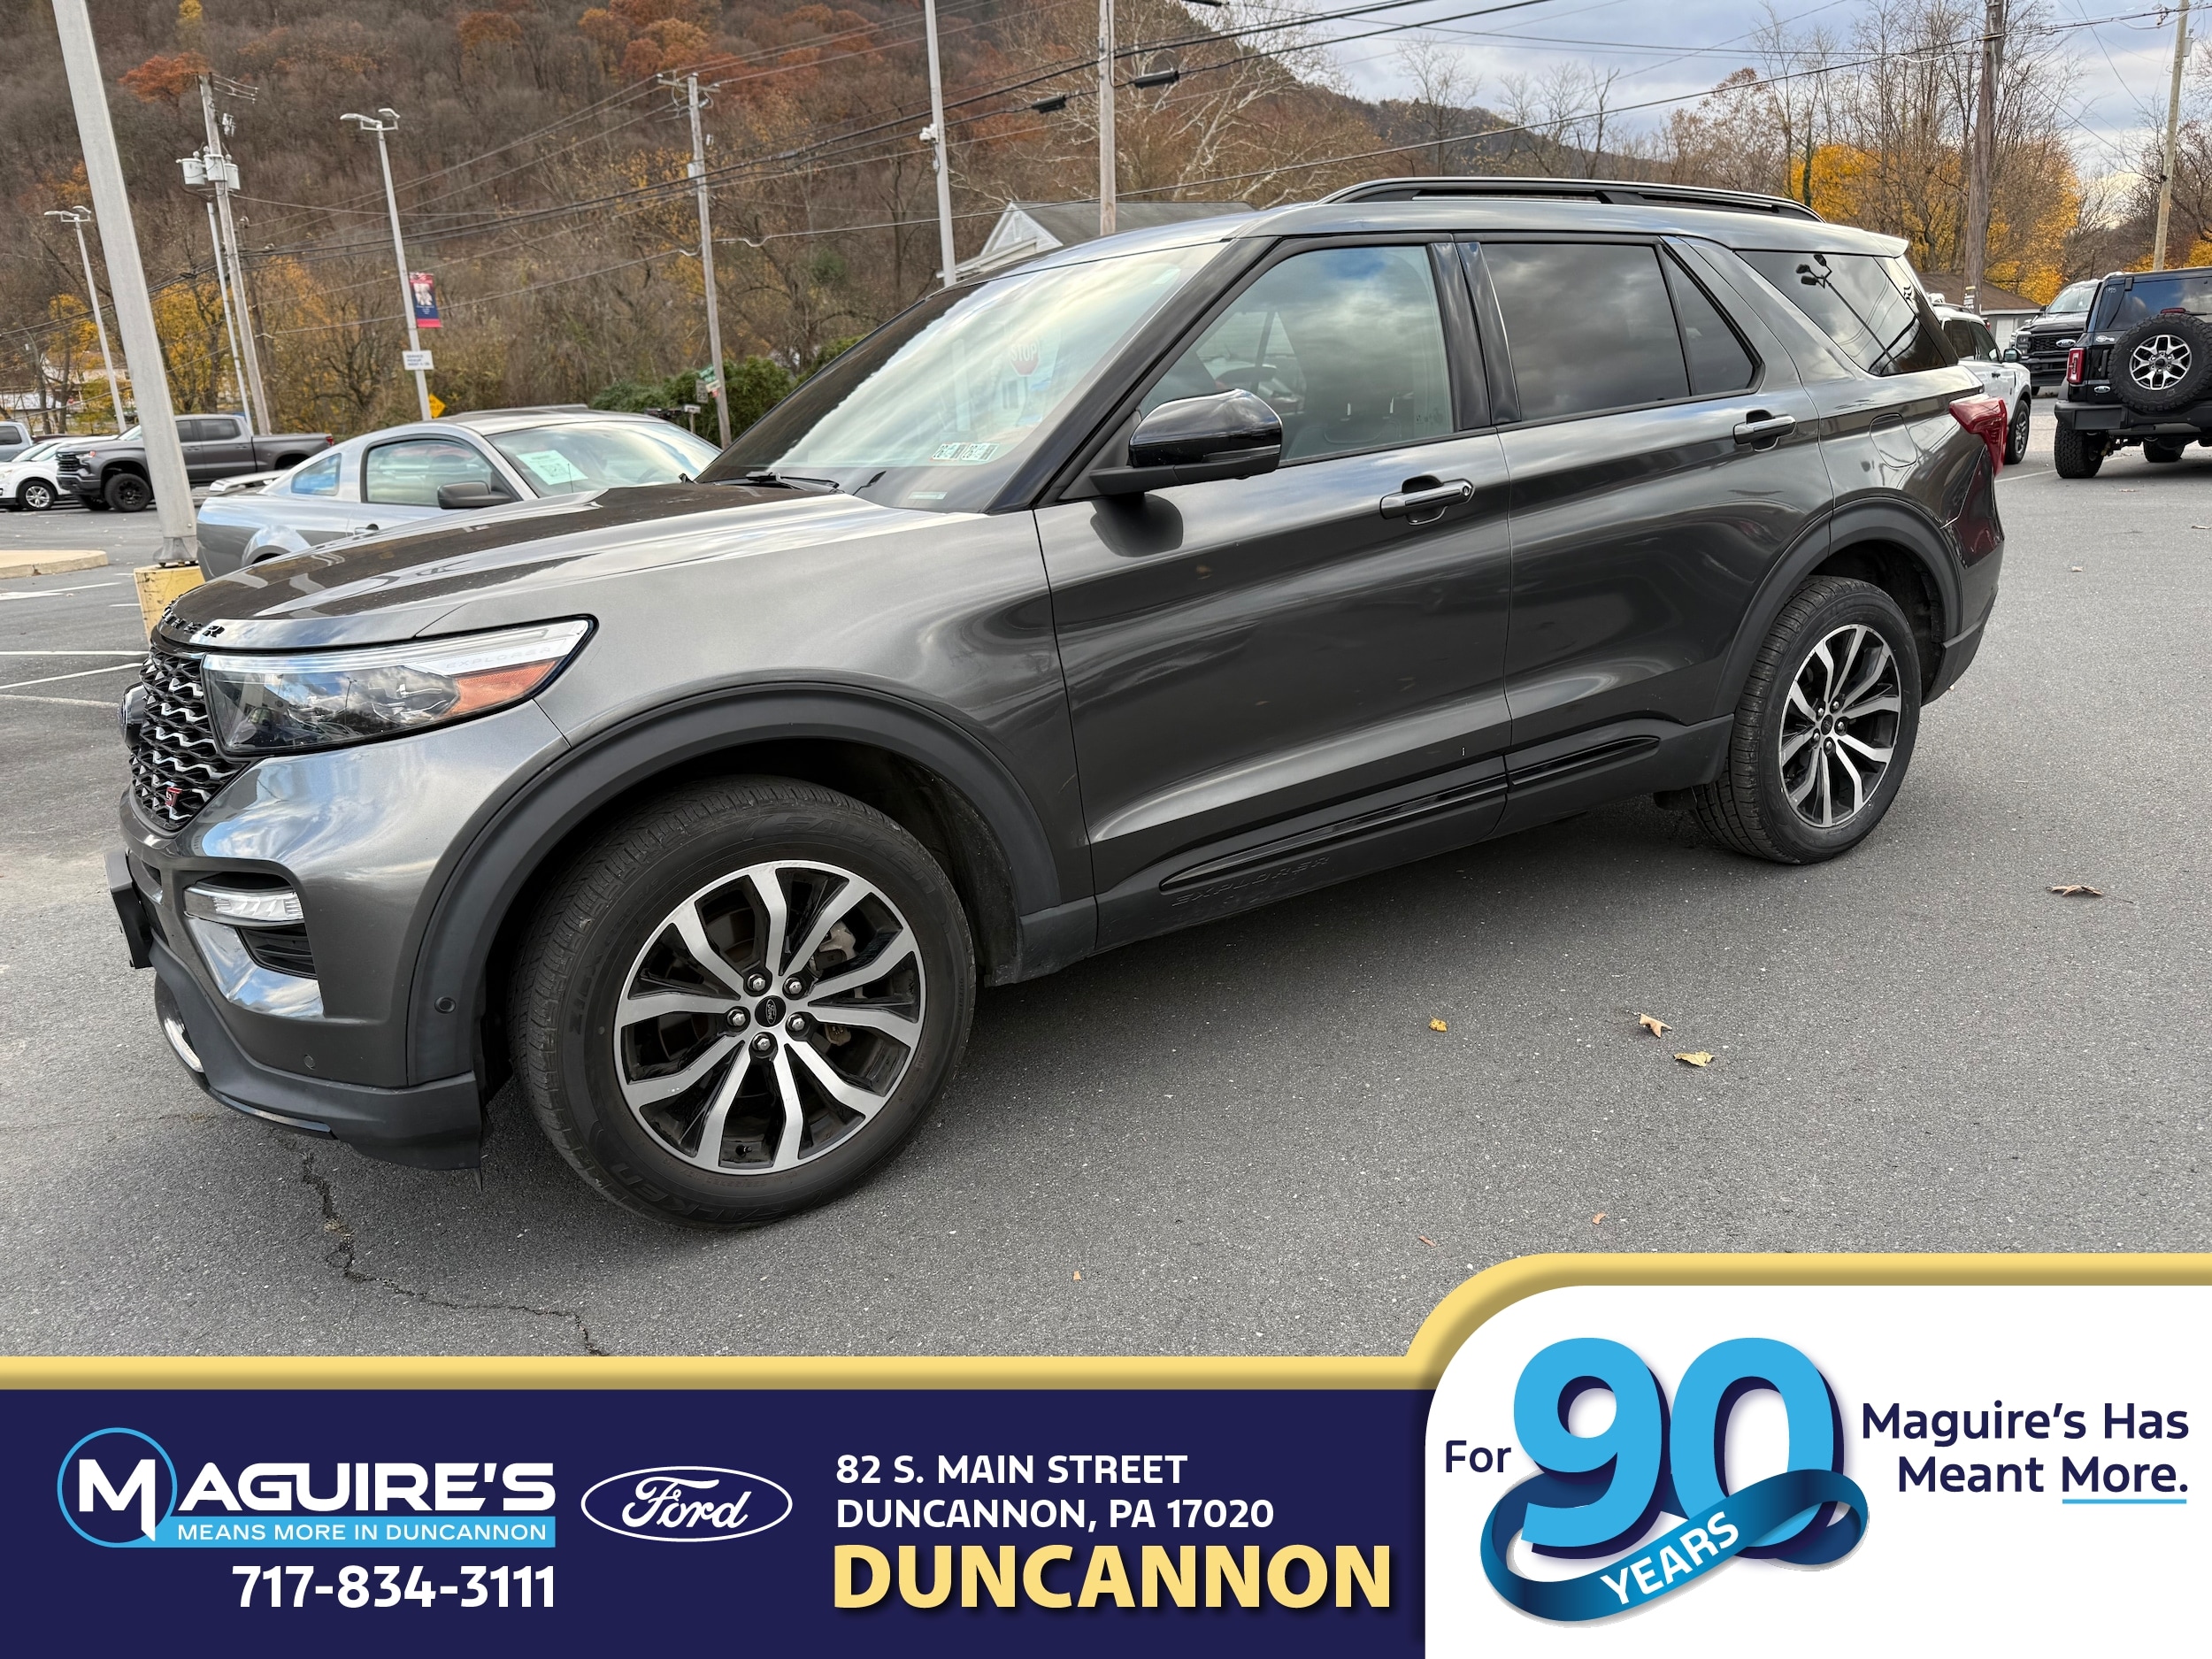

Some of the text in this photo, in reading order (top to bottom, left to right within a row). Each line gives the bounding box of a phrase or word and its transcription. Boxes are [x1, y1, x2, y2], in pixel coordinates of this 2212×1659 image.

[1010, 342, 1038, 362] STOP
[445, 647, 551, 669] EXPLORER
[165, 787, 183, 808] ST
[1171, 856, 1331, 907] EXPLORER
